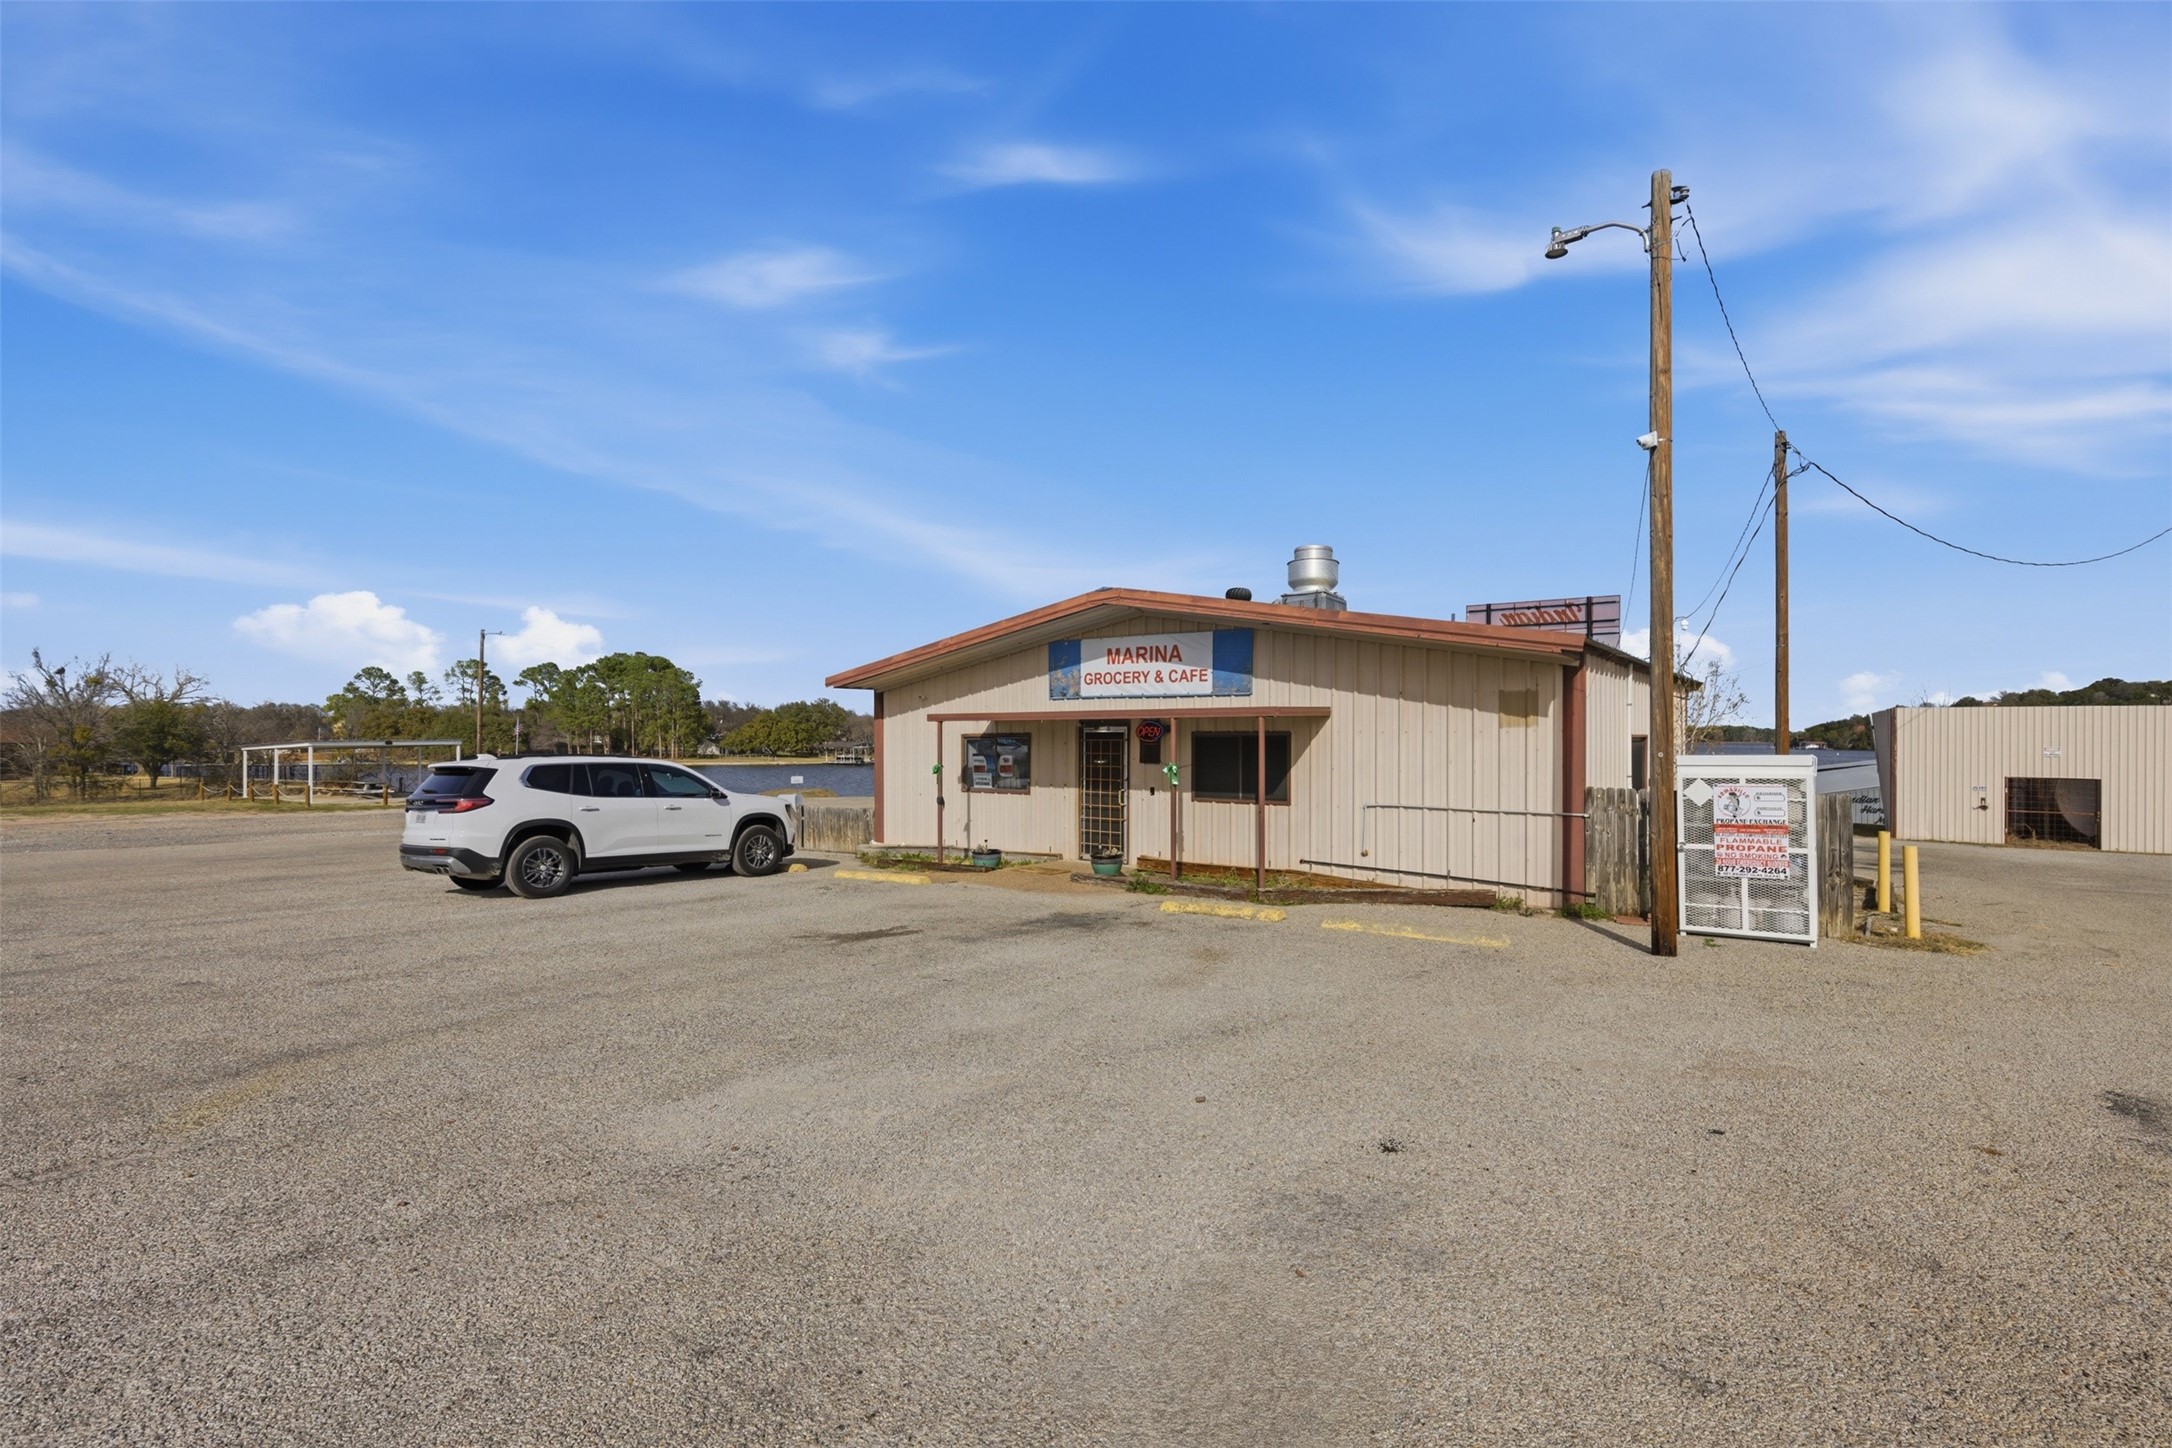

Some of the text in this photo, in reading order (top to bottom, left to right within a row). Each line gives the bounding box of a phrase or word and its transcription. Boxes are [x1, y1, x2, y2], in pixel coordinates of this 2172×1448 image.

[1106, 644, 1182, 665] MARINA
[1084, 668, 1208, 685] GROCERY & CAFE
[1137, 724, 1161, 737] OPEN
[1720, 837, 1783, 845] FLAMMABLE
[1716, 844, 1787, 853] PROPANE
[1739, 852, 1779, 860] SMOKING
